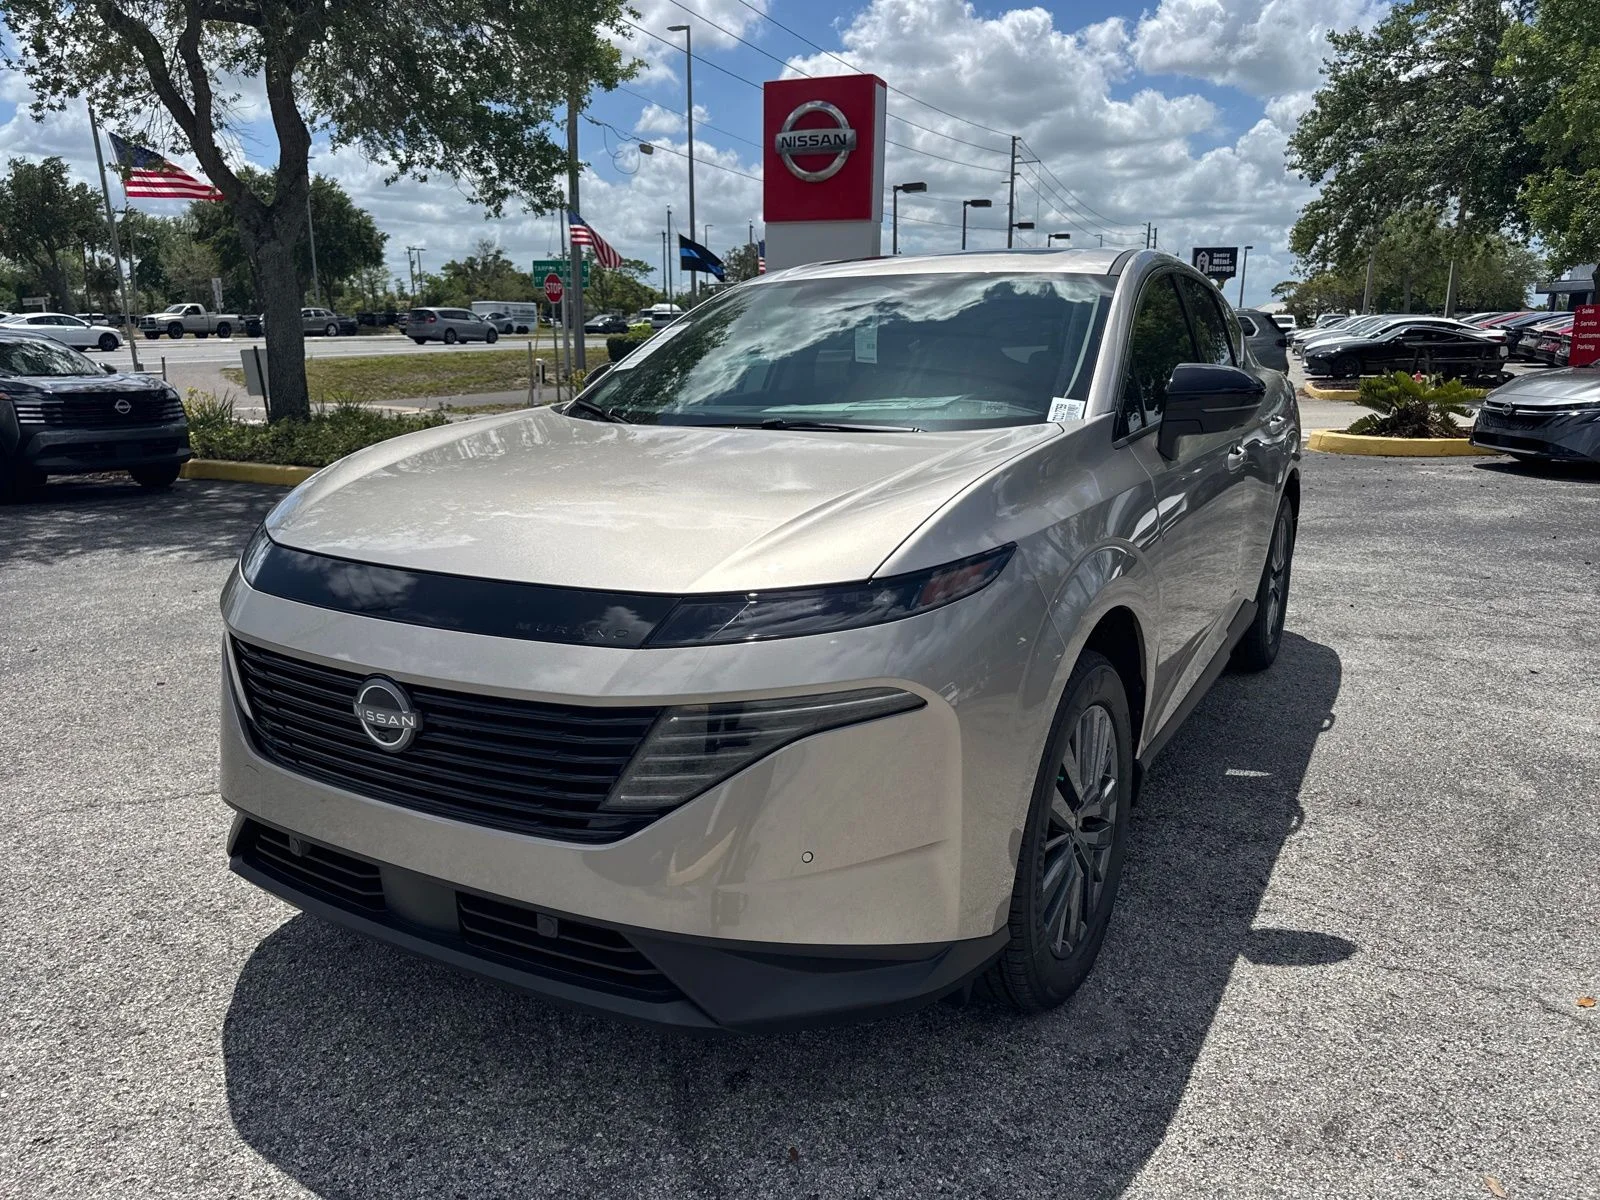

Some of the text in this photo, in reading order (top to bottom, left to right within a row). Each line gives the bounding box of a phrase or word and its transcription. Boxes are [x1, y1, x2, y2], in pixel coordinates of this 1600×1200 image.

[781, 134, 847, 149] NISSAN
[545, 282, 562, 294] STOP
[354, 704, 414, 726] NISSAN
